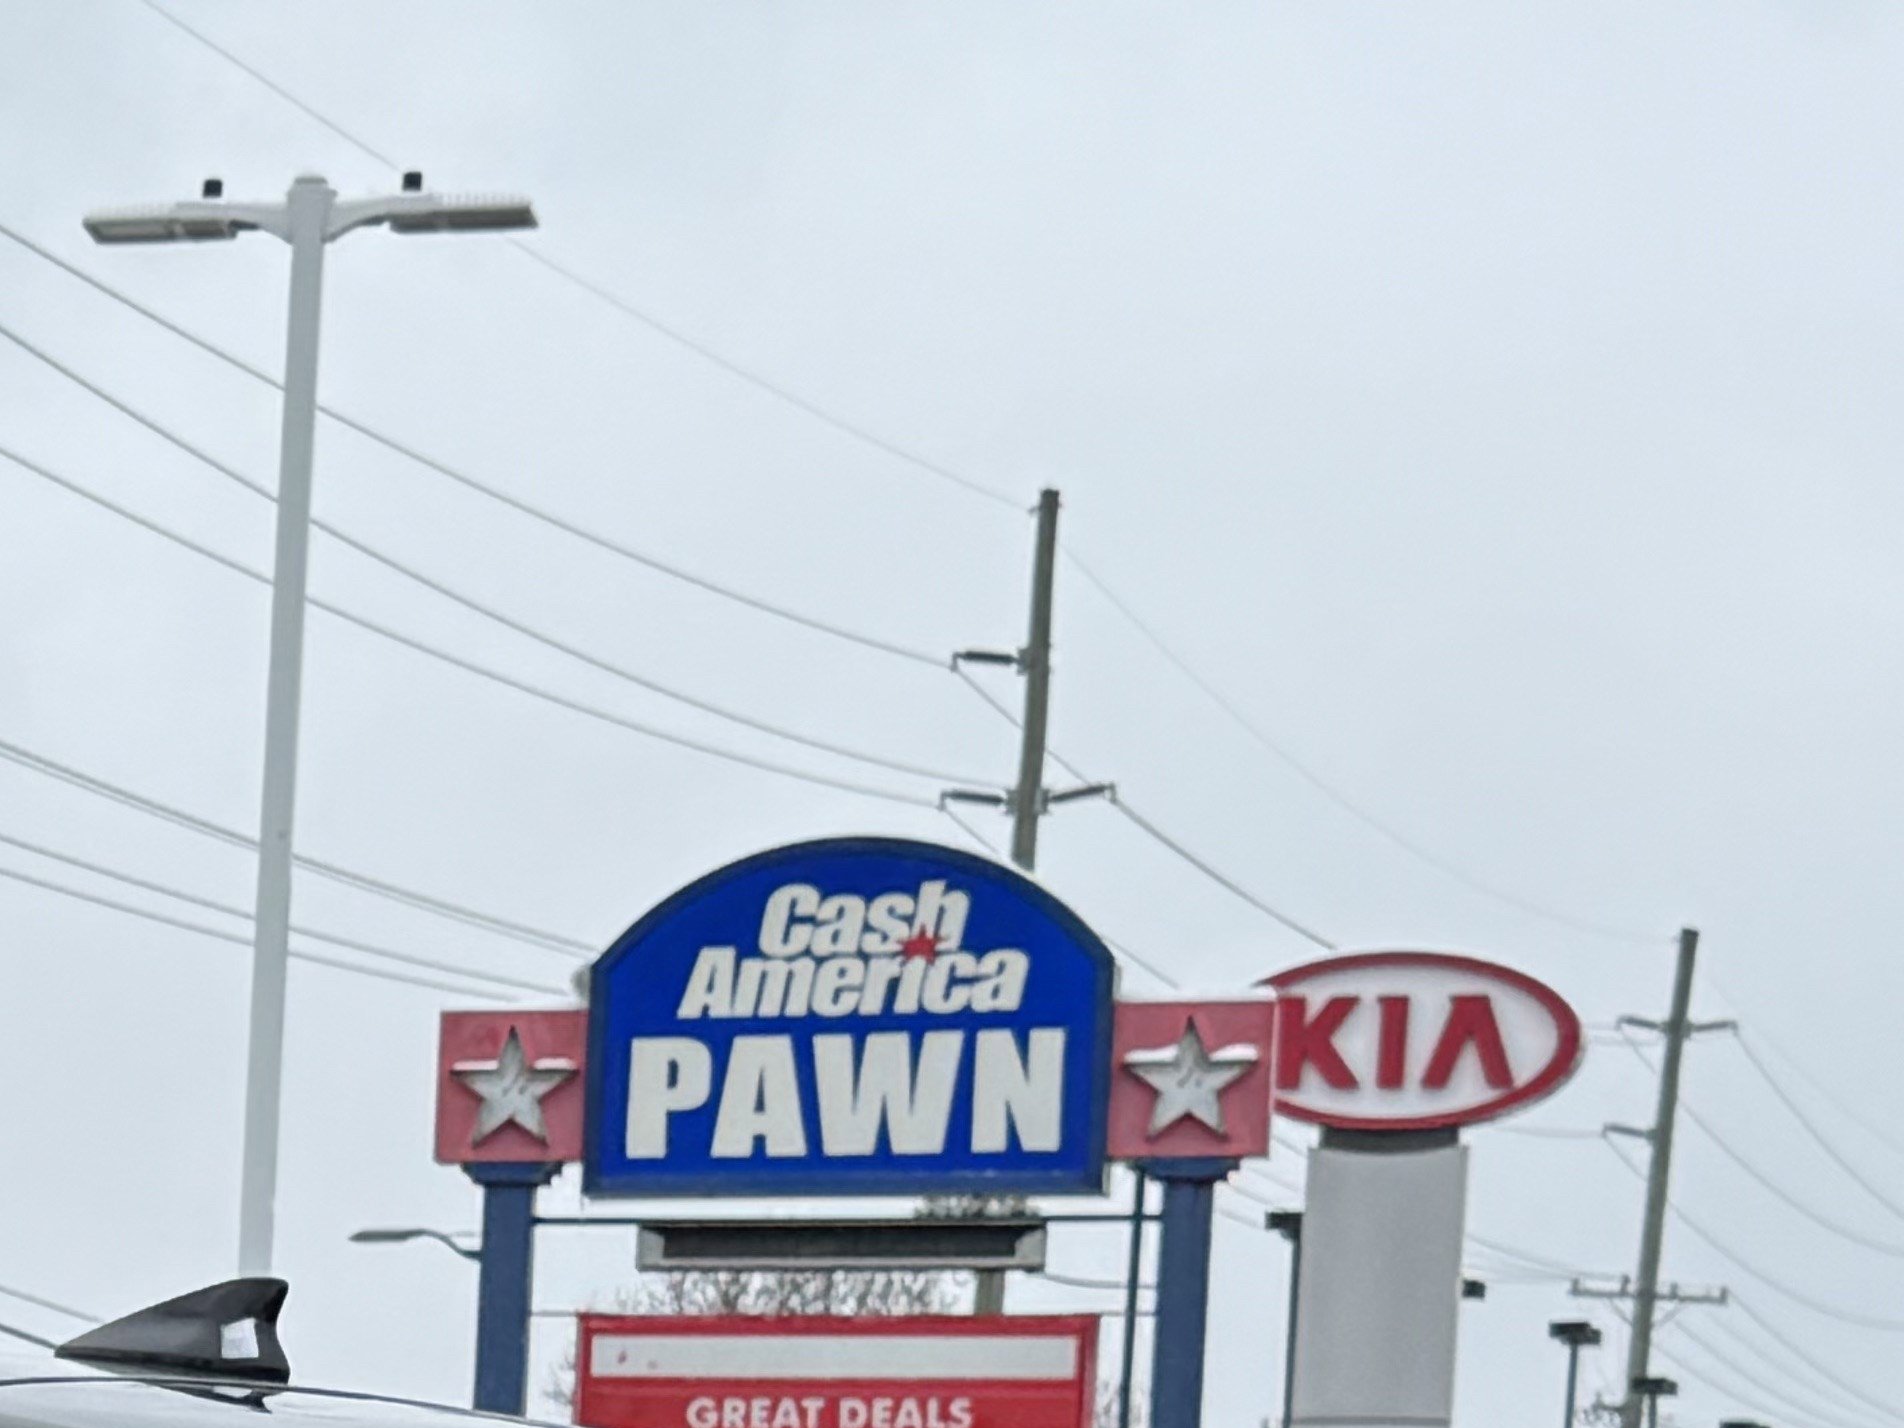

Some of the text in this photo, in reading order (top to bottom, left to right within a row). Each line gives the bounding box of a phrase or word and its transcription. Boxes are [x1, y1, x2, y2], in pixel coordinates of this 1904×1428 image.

[758, 879, 970, 958] Cash
[676, 945, 1030, 1020] America
[1277, 995, 1514, 1090] KIA
[626, 1026, 1066, 1160] PAWN
